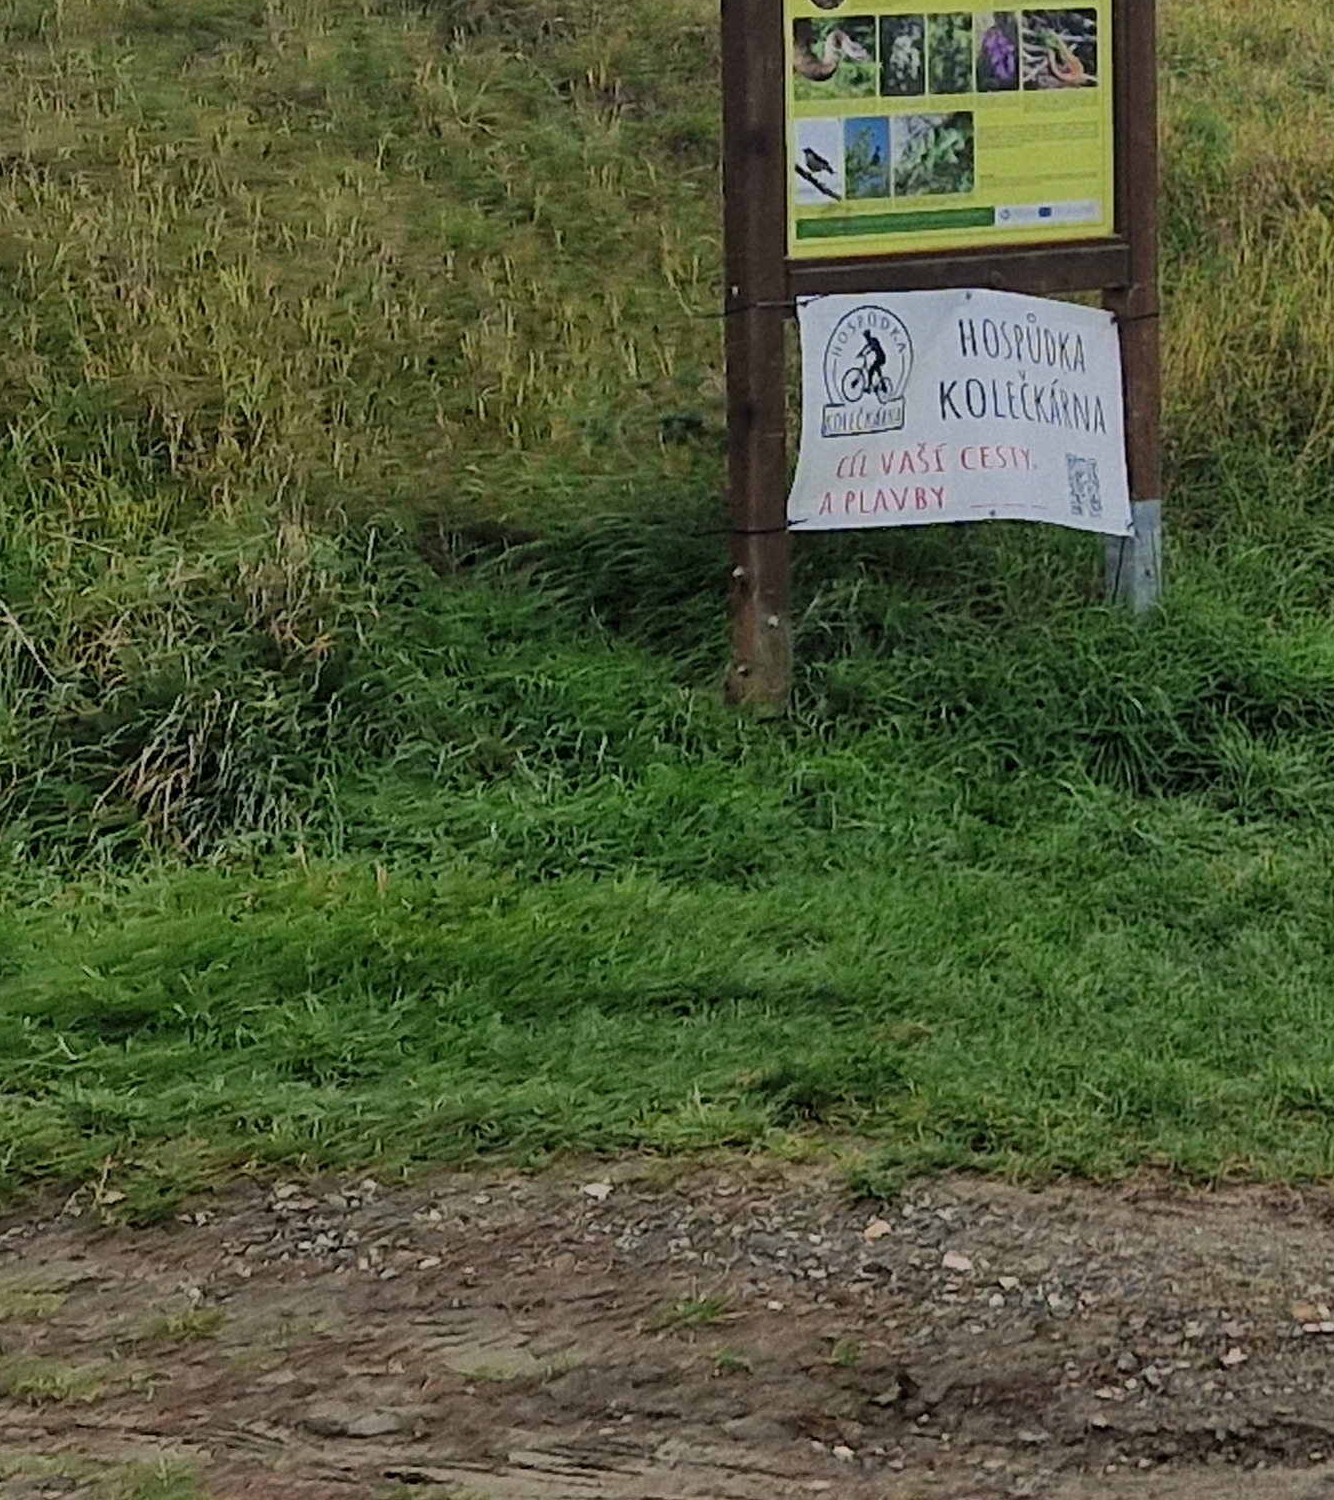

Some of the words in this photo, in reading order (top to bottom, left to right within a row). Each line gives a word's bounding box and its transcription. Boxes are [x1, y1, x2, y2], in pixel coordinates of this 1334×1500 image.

[958, 313, 1086, 373] HOSPŮDKA
[939, 370, 1107, 435] KOLEČKÁRNA
[835, 449, 868, 479] CÍL
[880, 442, 948, 476] VAŠÍ
[819, 491, 833, 515] A
[844, 486, 946, 514] PLAVBY
